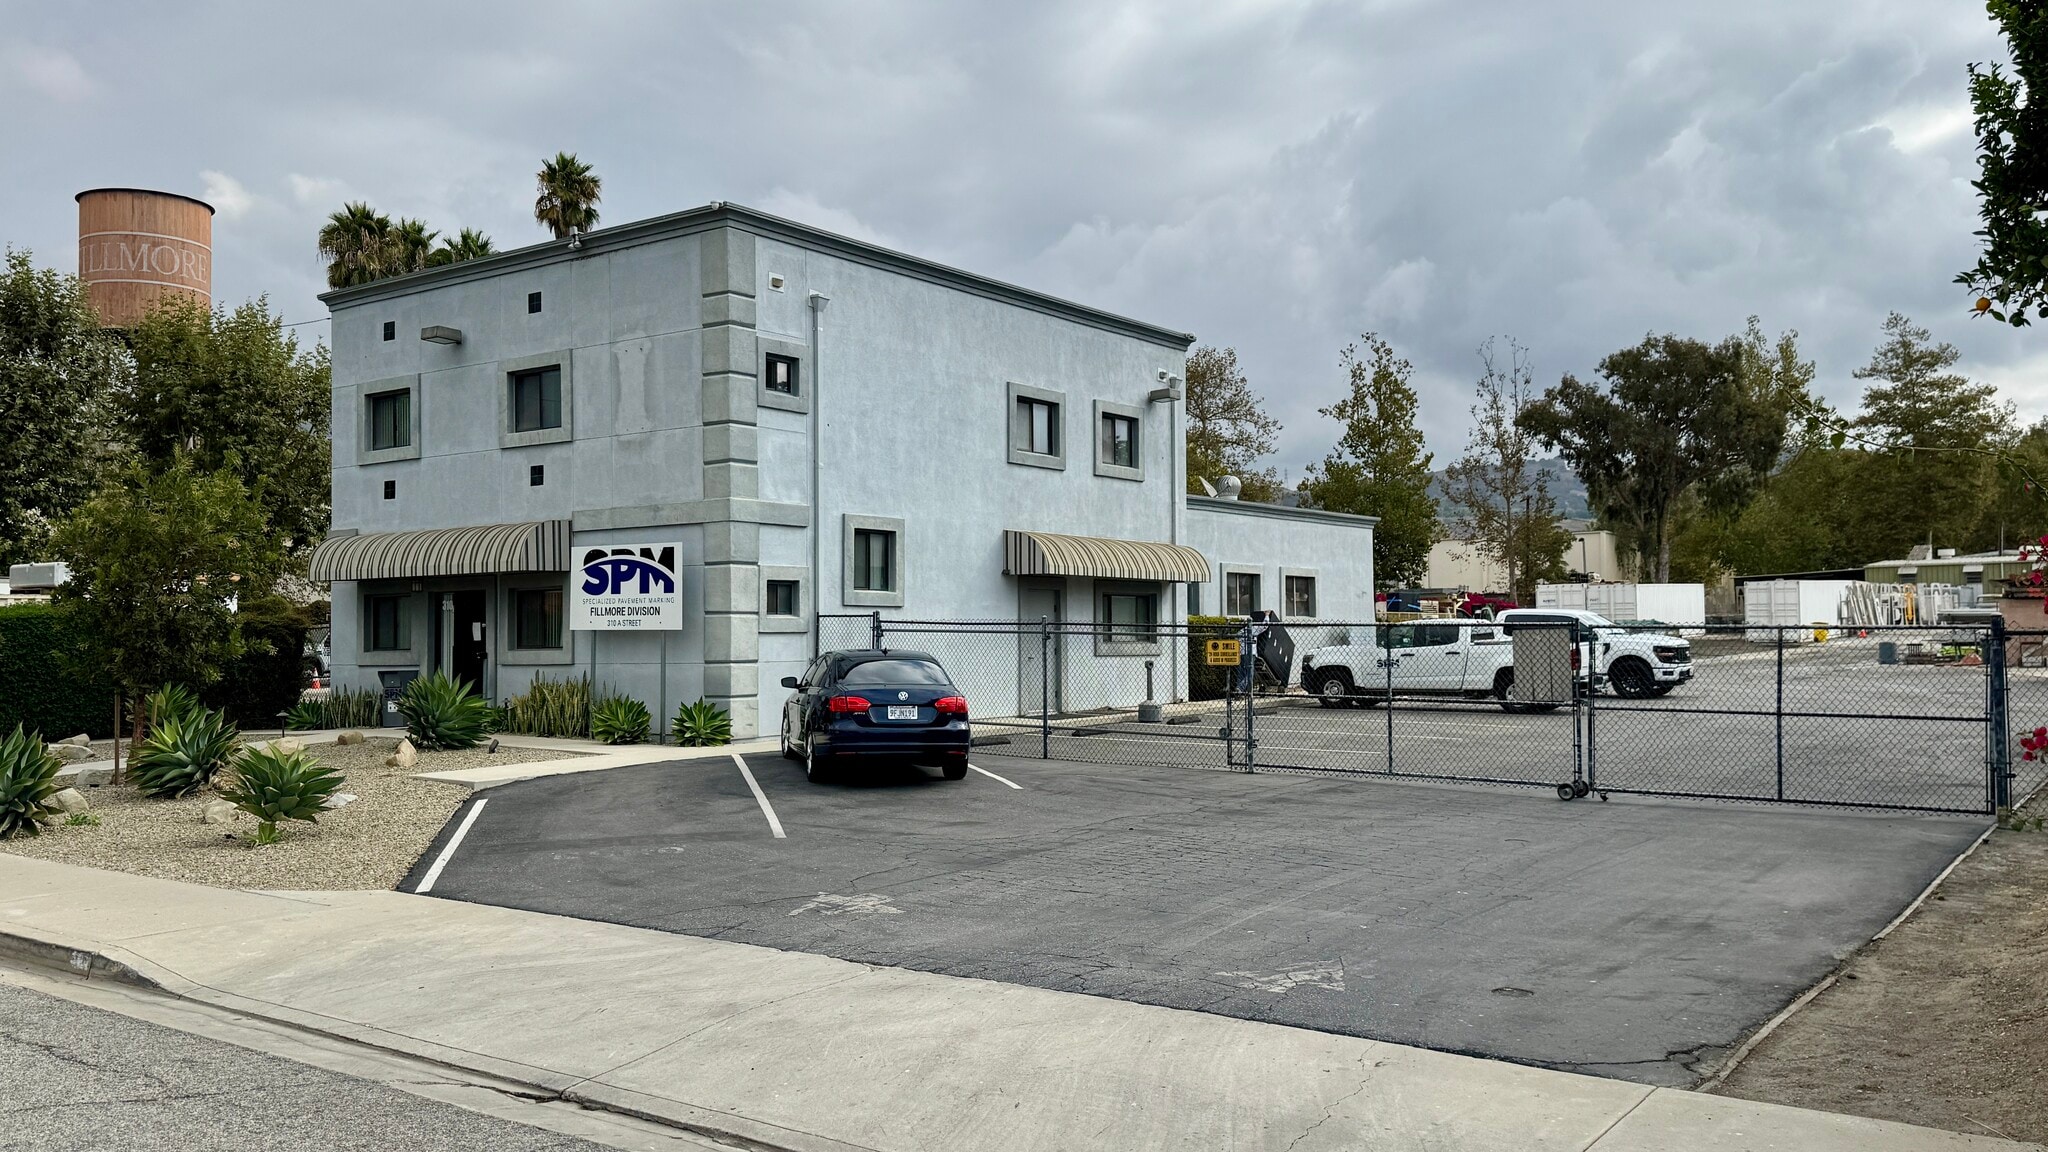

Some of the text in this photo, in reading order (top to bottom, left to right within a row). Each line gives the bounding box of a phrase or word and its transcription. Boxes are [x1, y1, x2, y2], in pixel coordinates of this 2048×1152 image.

[80, 242, 207, 284] ILLMORE
[580, 546, 675, 596] SPM
[648, 596, 675, 604] MARKING
[590, 606, 661, 616] FILLMORE DIVISION
[607, 619, 642, 627] 310 A STREET
